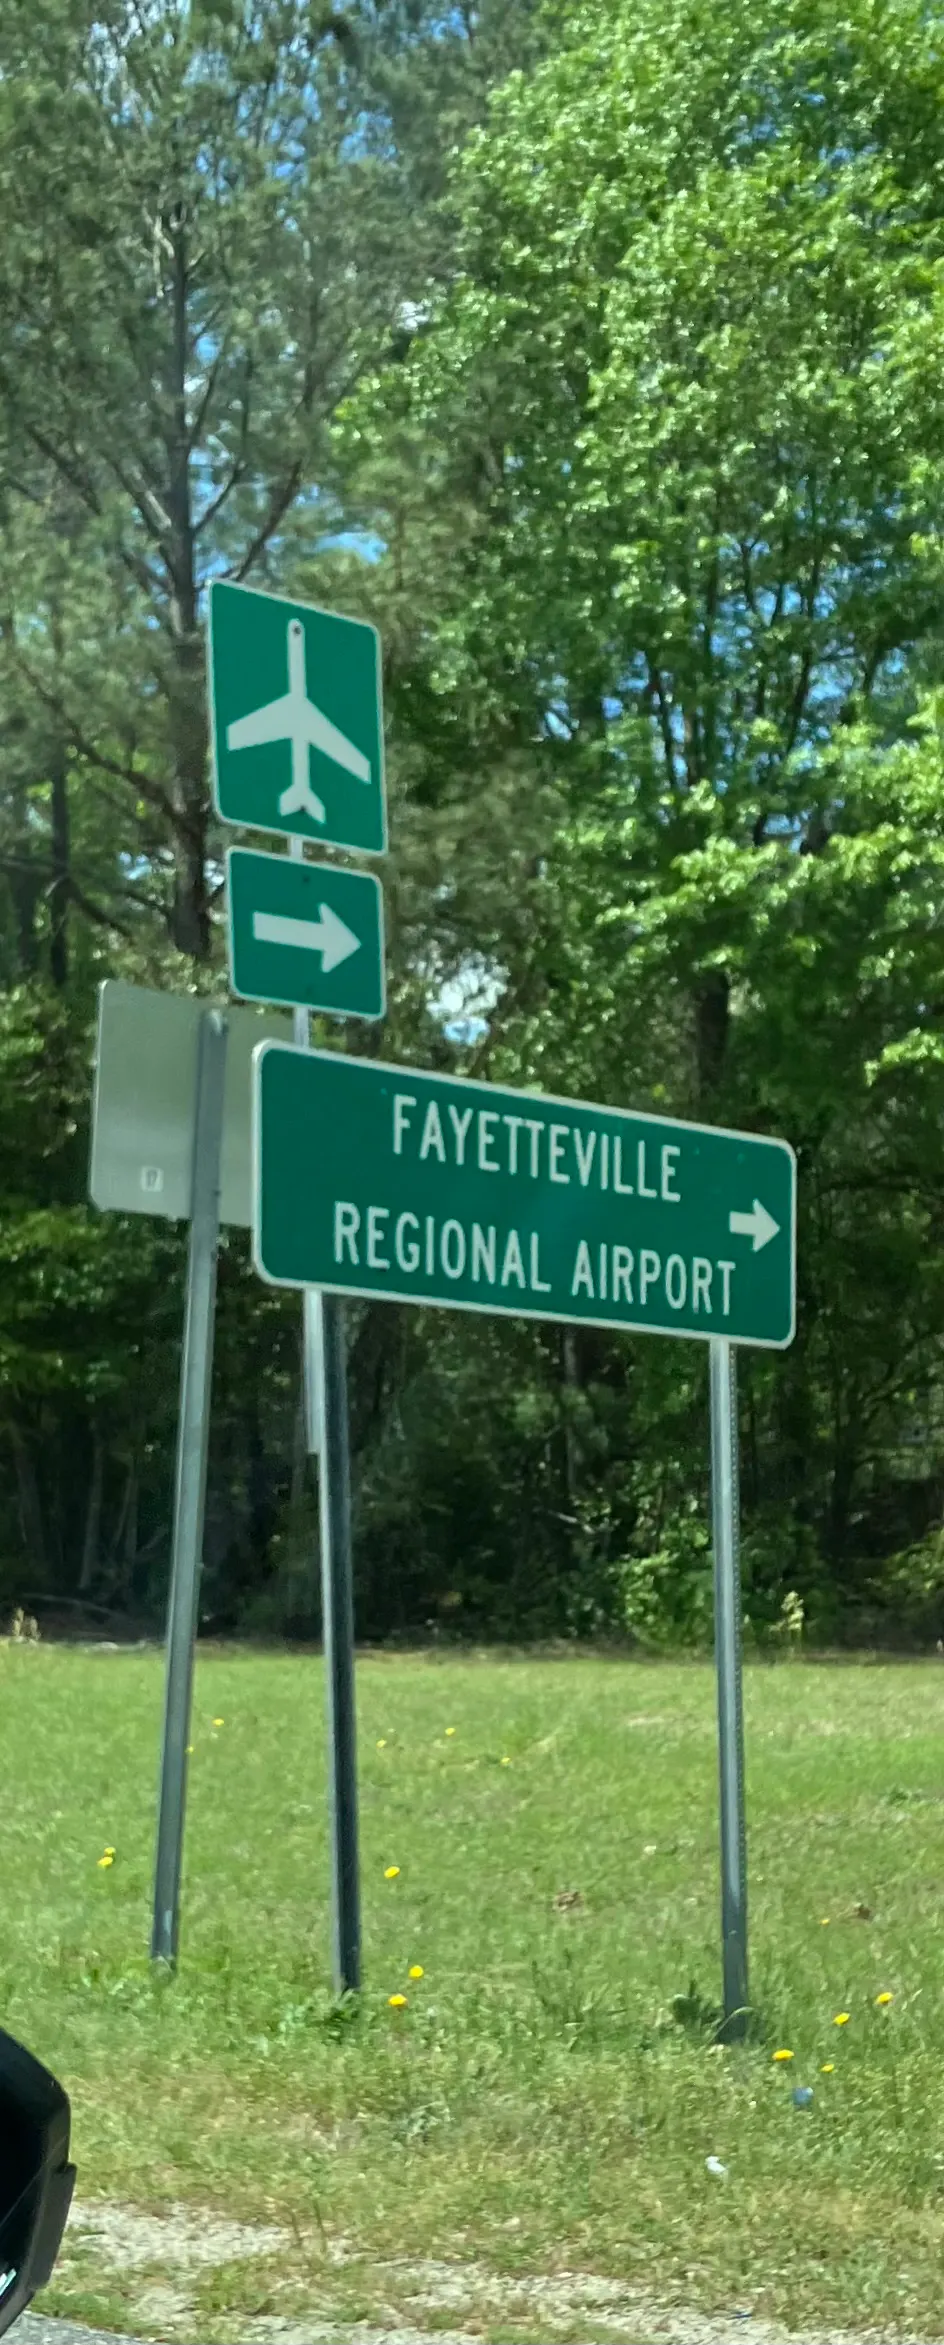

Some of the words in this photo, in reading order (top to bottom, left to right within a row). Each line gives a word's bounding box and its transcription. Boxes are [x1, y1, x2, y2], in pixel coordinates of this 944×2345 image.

[392, 1094, 682, 1202] FAYETTEVILLE
[333, 1201, 552, 1292] REGIONAL
[571, 1240, 737, 1316] AIRPORT
